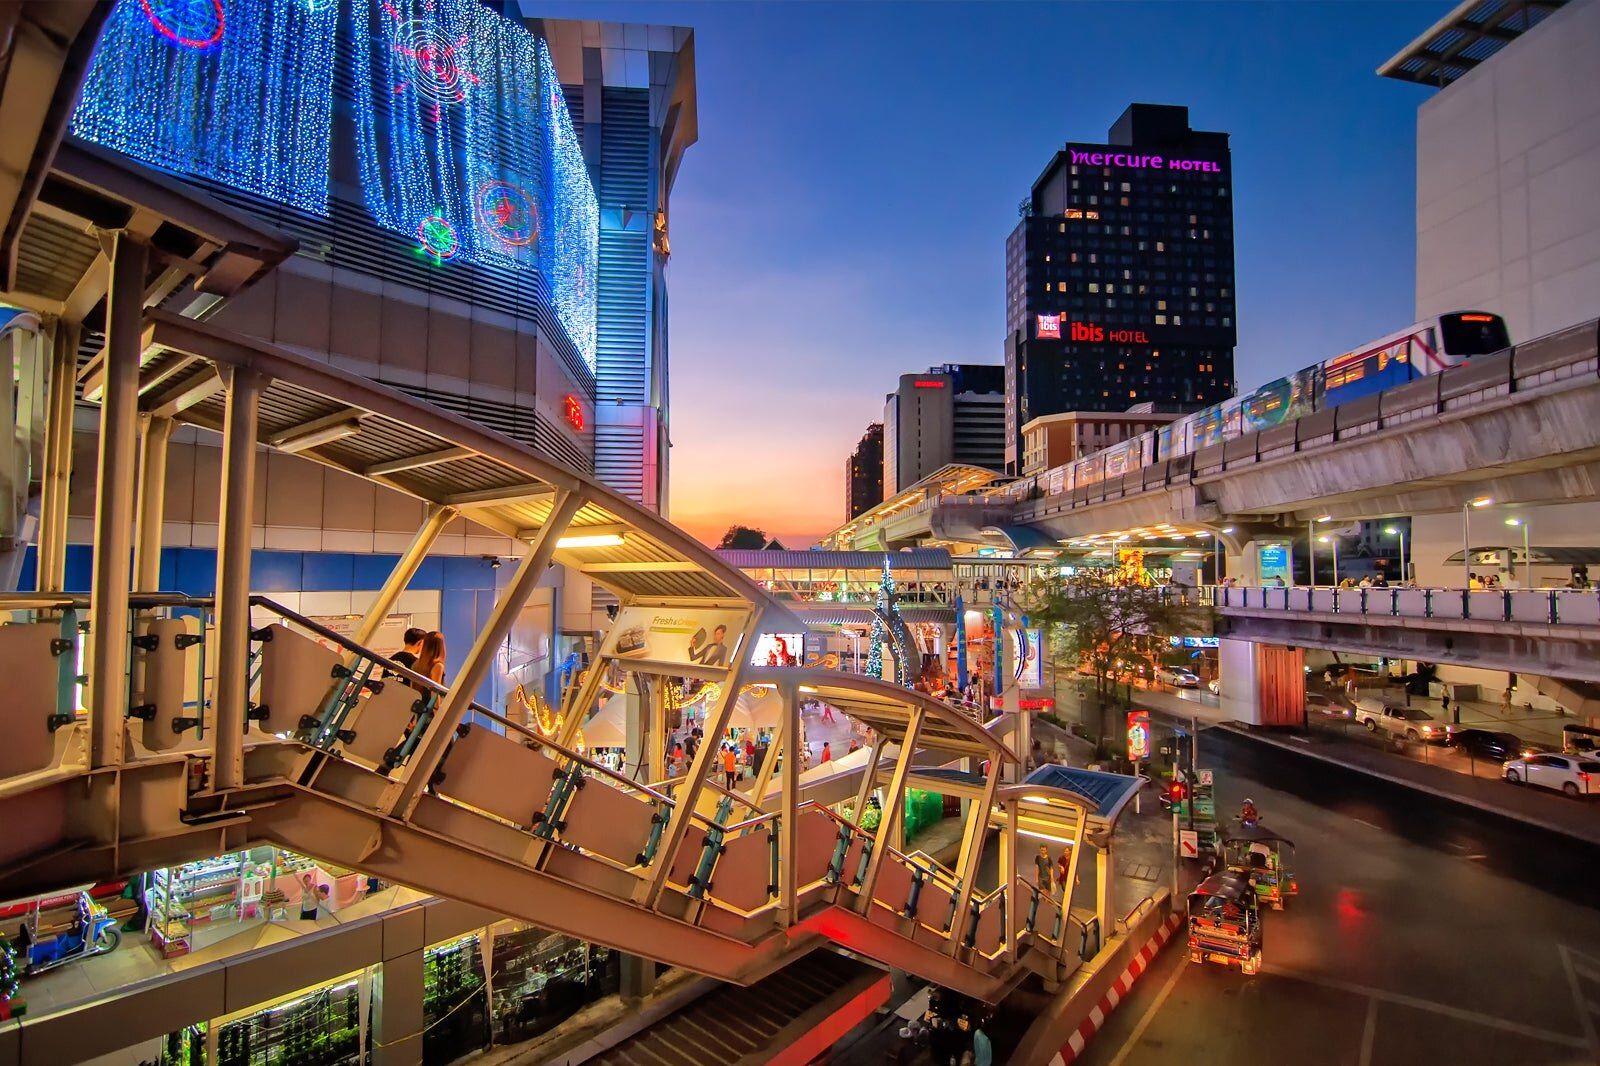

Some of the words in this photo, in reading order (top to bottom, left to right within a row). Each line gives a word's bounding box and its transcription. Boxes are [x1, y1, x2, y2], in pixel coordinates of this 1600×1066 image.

[1169, 160, 1221, 172] HOTEL
[1040, 319, 1058, 331] ibis
[1071, 322, 1104, 342] ibis
[1109, 330, 1149, 343] HOTEL
